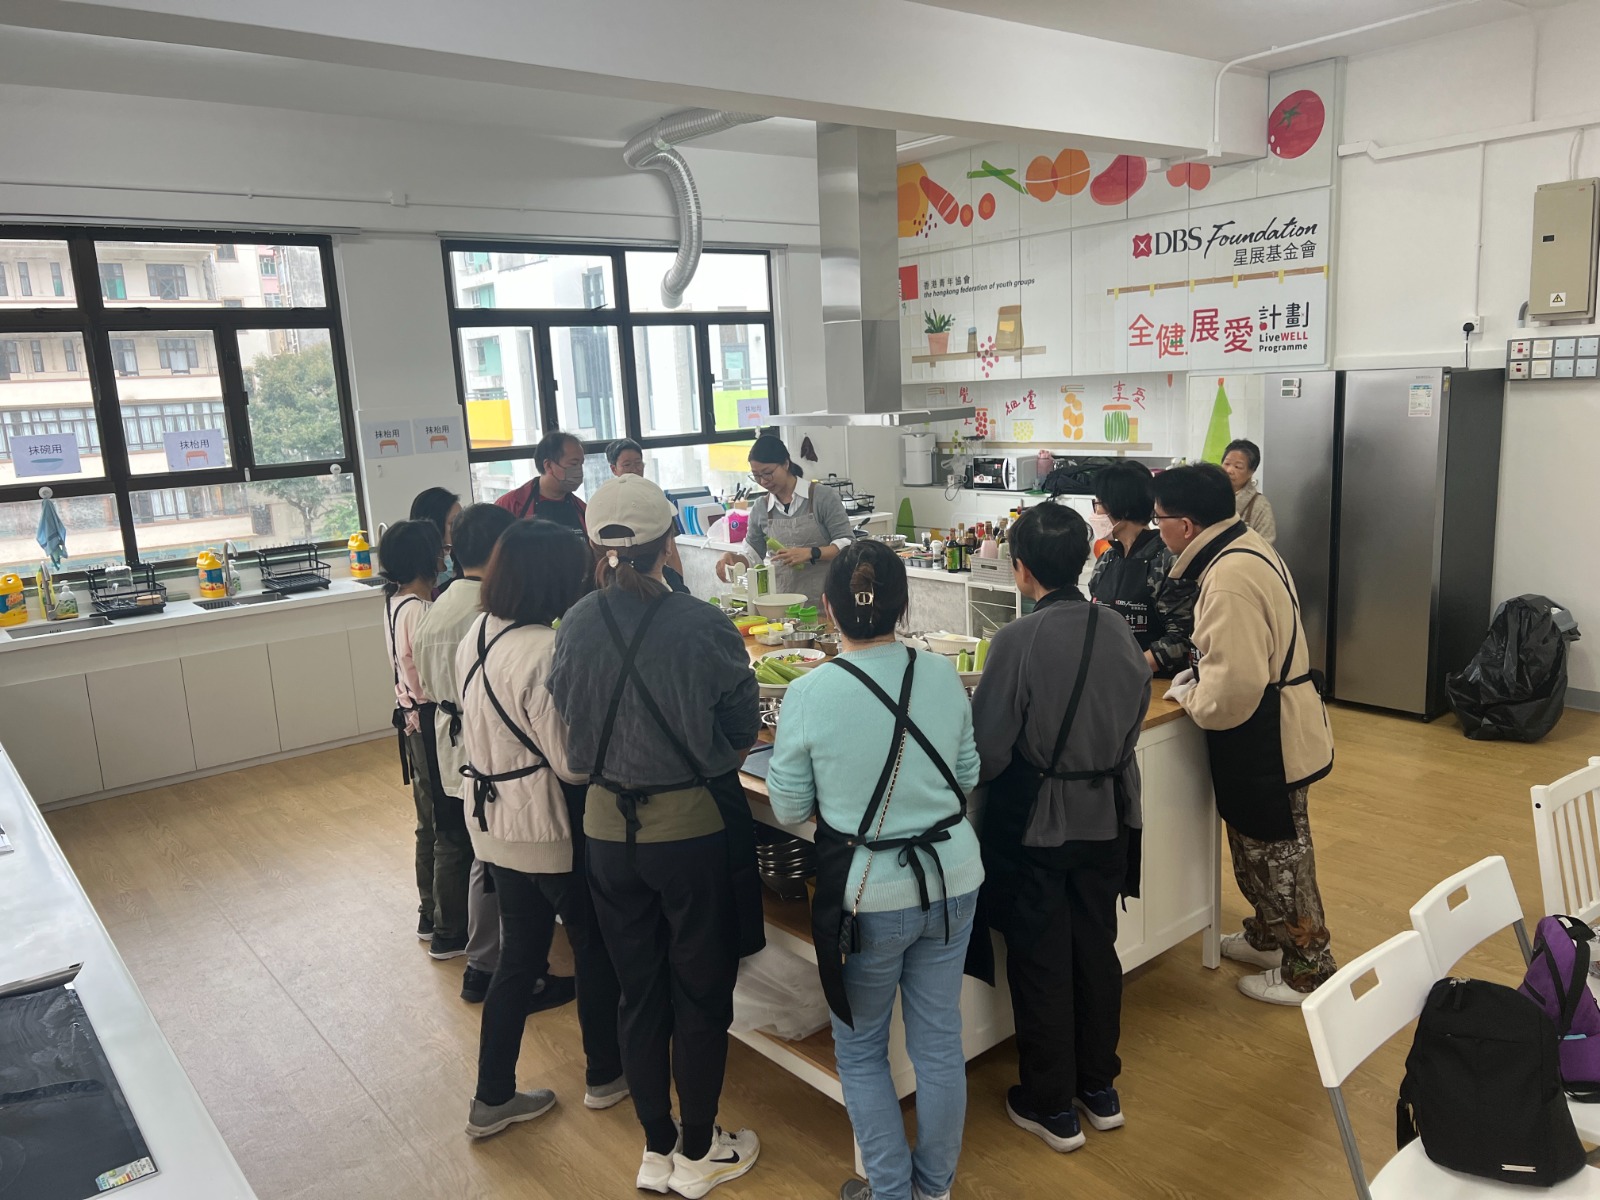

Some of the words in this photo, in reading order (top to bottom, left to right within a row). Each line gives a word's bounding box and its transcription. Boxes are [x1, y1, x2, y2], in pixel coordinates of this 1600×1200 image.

[1155, 226, 1202, 256] DBS
[1204, 216, 1318, 260] Foundation
[1233, 239, 1317, 267] 星展基金會
[923, 275, 970, 290] 香港青年協會
[933, 288, 959, 298] hongkong
[960, 283, 988, 293] federation
[989, 282, 995, 290] of
[996, 280, 1013, 290] youth
[1013, 278, 1035, 287] groups
[1259, 331, 1308, 342] LiveWELL
[1259, 342, 1308, 353] Programme
[28, 444, 63, 456] 抹碗用
[179, 439, 210, 450] 抹枱用
